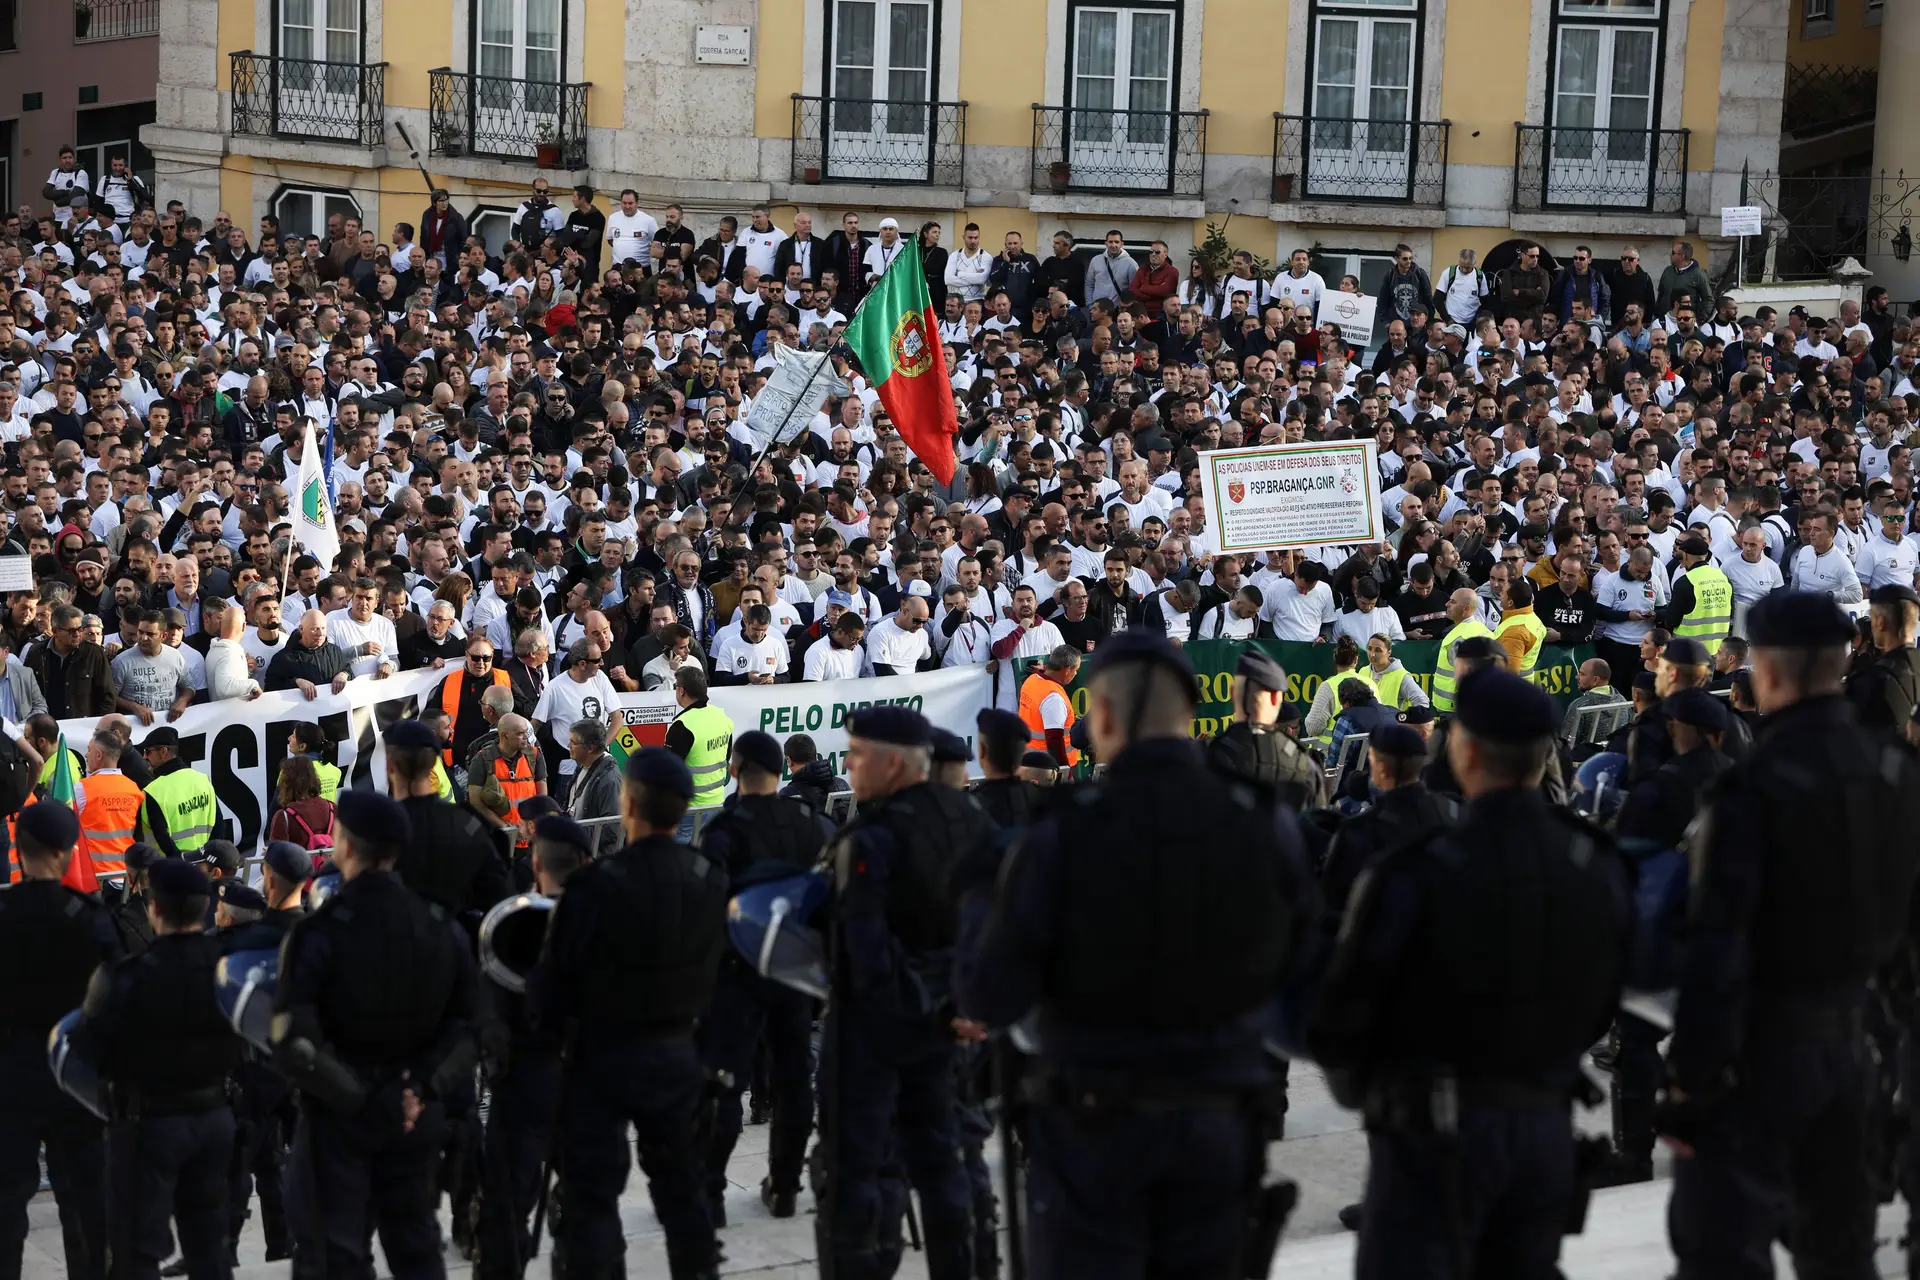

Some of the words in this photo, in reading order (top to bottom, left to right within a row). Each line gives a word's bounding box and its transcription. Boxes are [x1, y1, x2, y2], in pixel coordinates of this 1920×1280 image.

[133, 667, 156, 677] RULES
[759, 703, 823, 733] PELO
[621, 733, 634, 748] G
